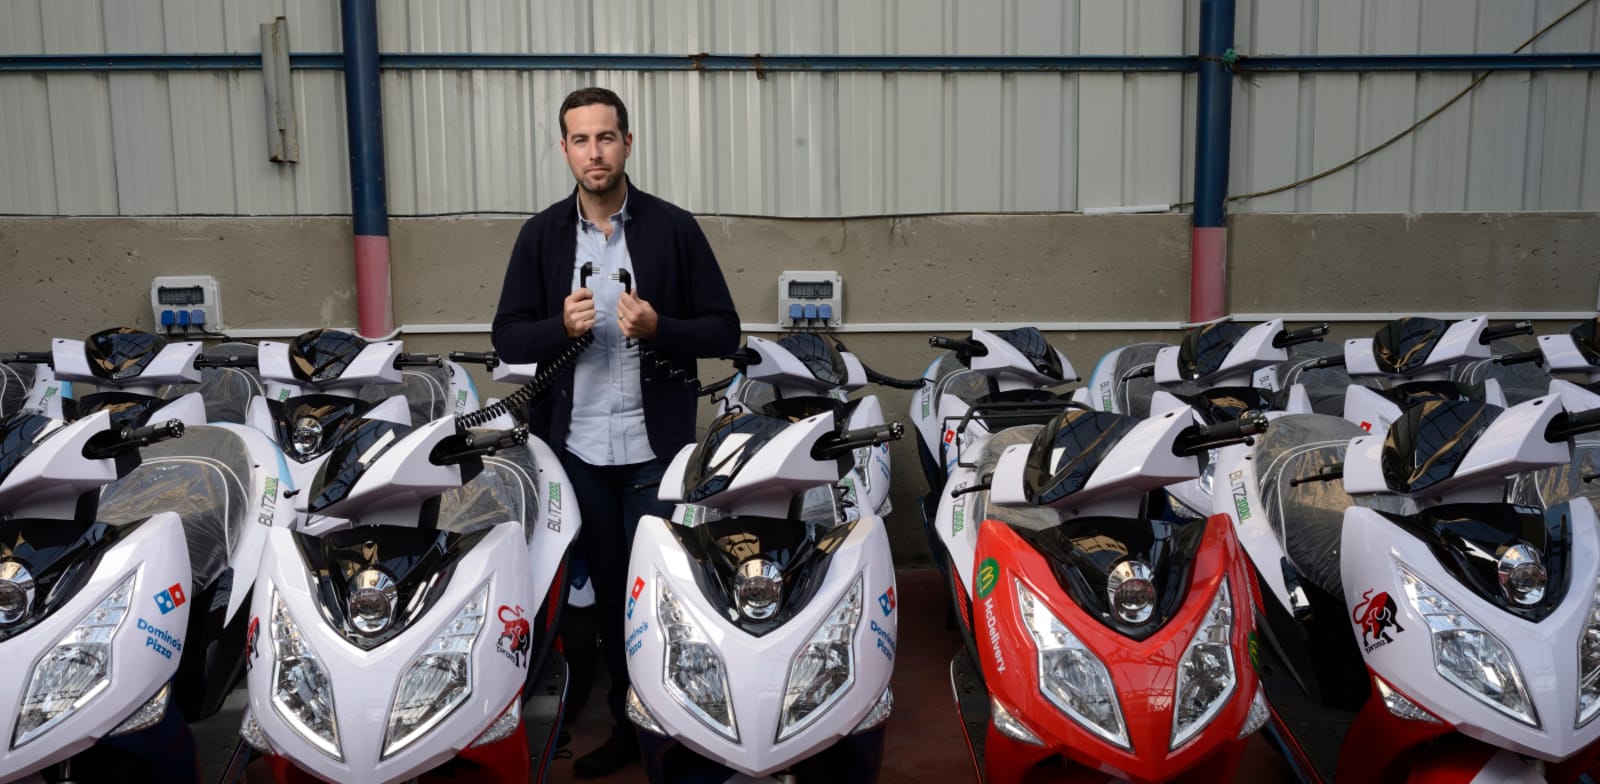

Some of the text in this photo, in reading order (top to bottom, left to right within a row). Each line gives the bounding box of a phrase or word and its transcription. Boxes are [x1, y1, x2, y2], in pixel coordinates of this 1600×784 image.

[136, 618, 182, 652] Domino's
[146, 636, 172, 659] Pizza
[984, 598, 1006, 674] McDelivery
